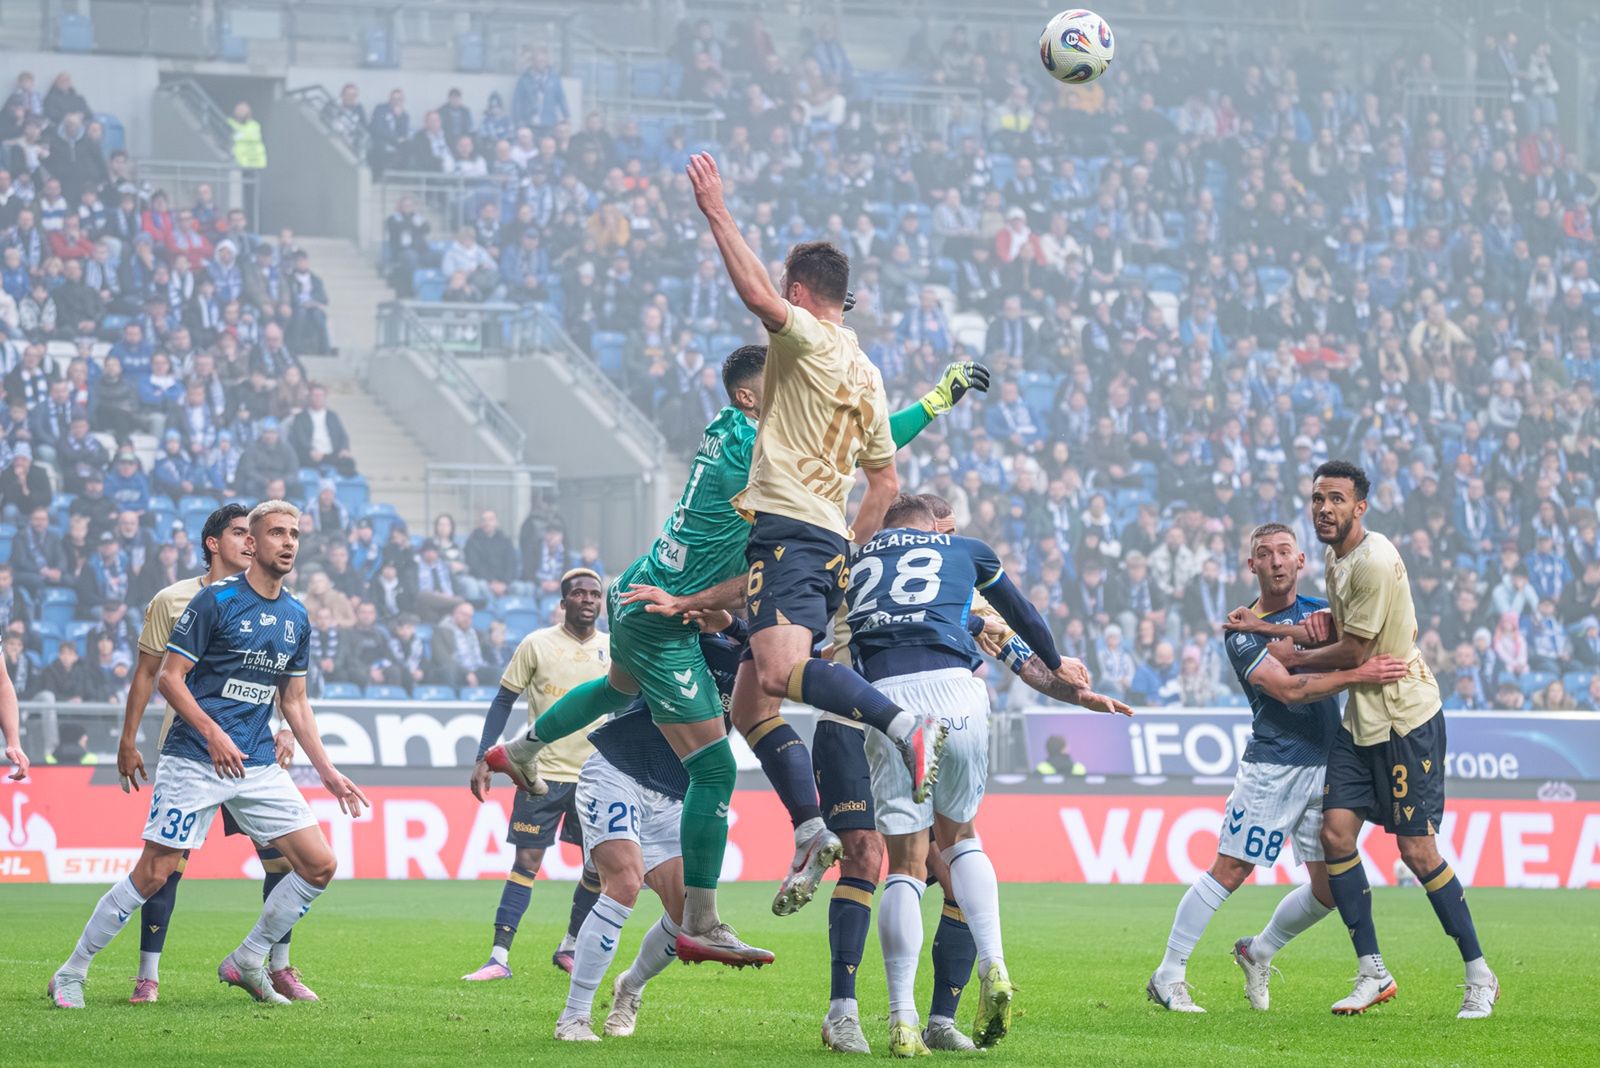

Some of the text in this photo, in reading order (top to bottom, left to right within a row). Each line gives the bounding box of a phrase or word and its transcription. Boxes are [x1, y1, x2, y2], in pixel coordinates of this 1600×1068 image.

[851, 533, 951, 557] OLARSKI
[845, 547, 943, 614] 28
[1392, 764, 1409, 799] 3
[161, 808, 197, 842] 39
[1244, 825, 1284, 862] 68
[63, 857, 132, 875] STIH
